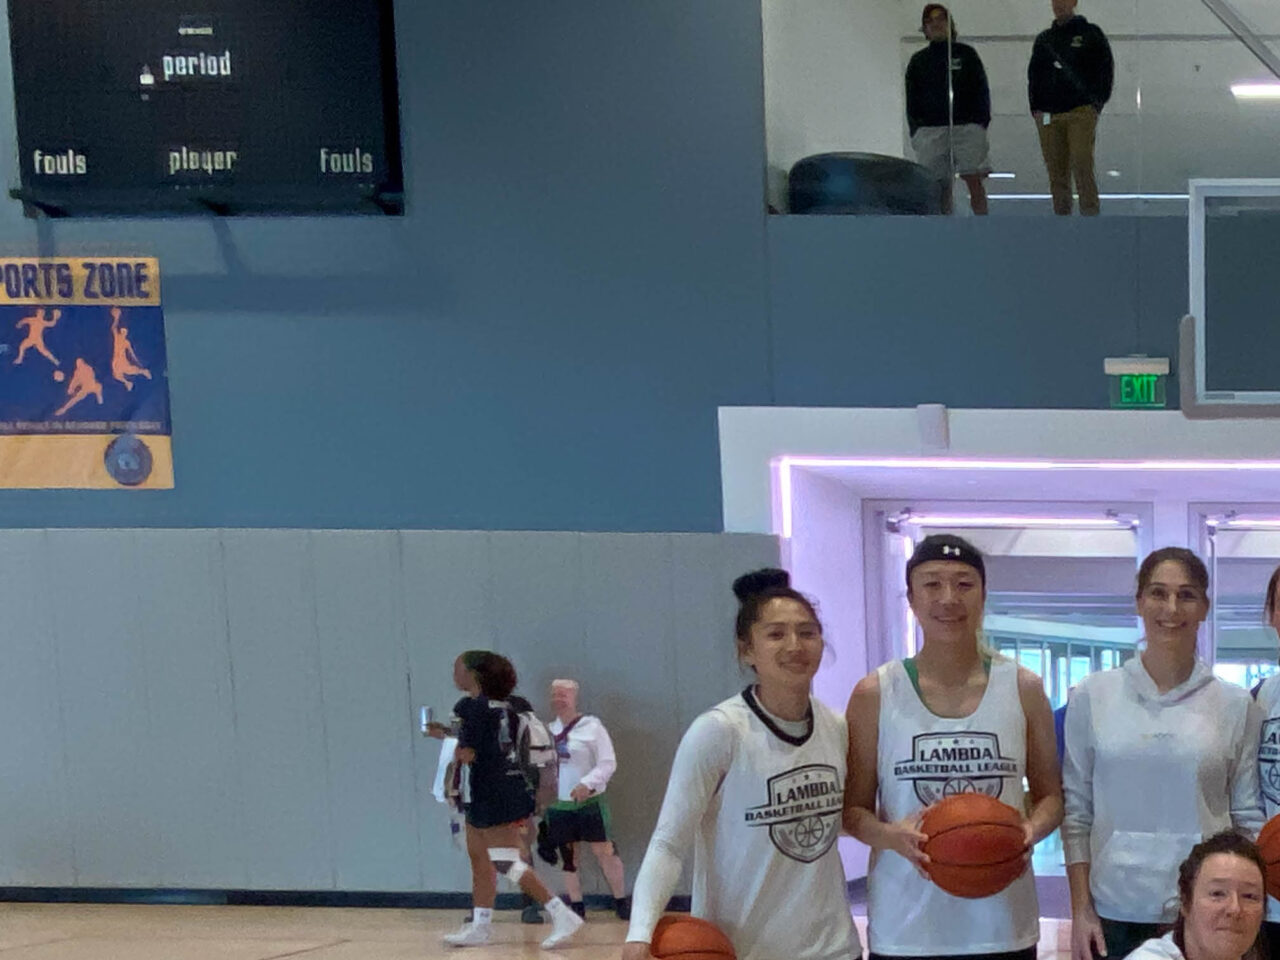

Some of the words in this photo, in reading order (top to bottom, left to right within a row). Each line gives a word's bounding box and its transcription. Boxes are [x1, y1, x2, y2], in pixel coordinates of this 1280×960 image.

[162, 50, 231, 81] period
[33, 149, 87, 174] fouls
[168, 146, 238, 175] player
[320, 148, 373, 173] fouls
[0, 263, 74, 299] ORTS
[82, 262, 151, 299] ZONE
[1121, 375, 1157, 402] EXIT
[920, 747, 994, 761] LAMBDA
[893, 763, 974, 776] BASKETBALL
[777, 781, 836, 806] LAMBDA
[744, 800, 824, 822] BASKETBALL
